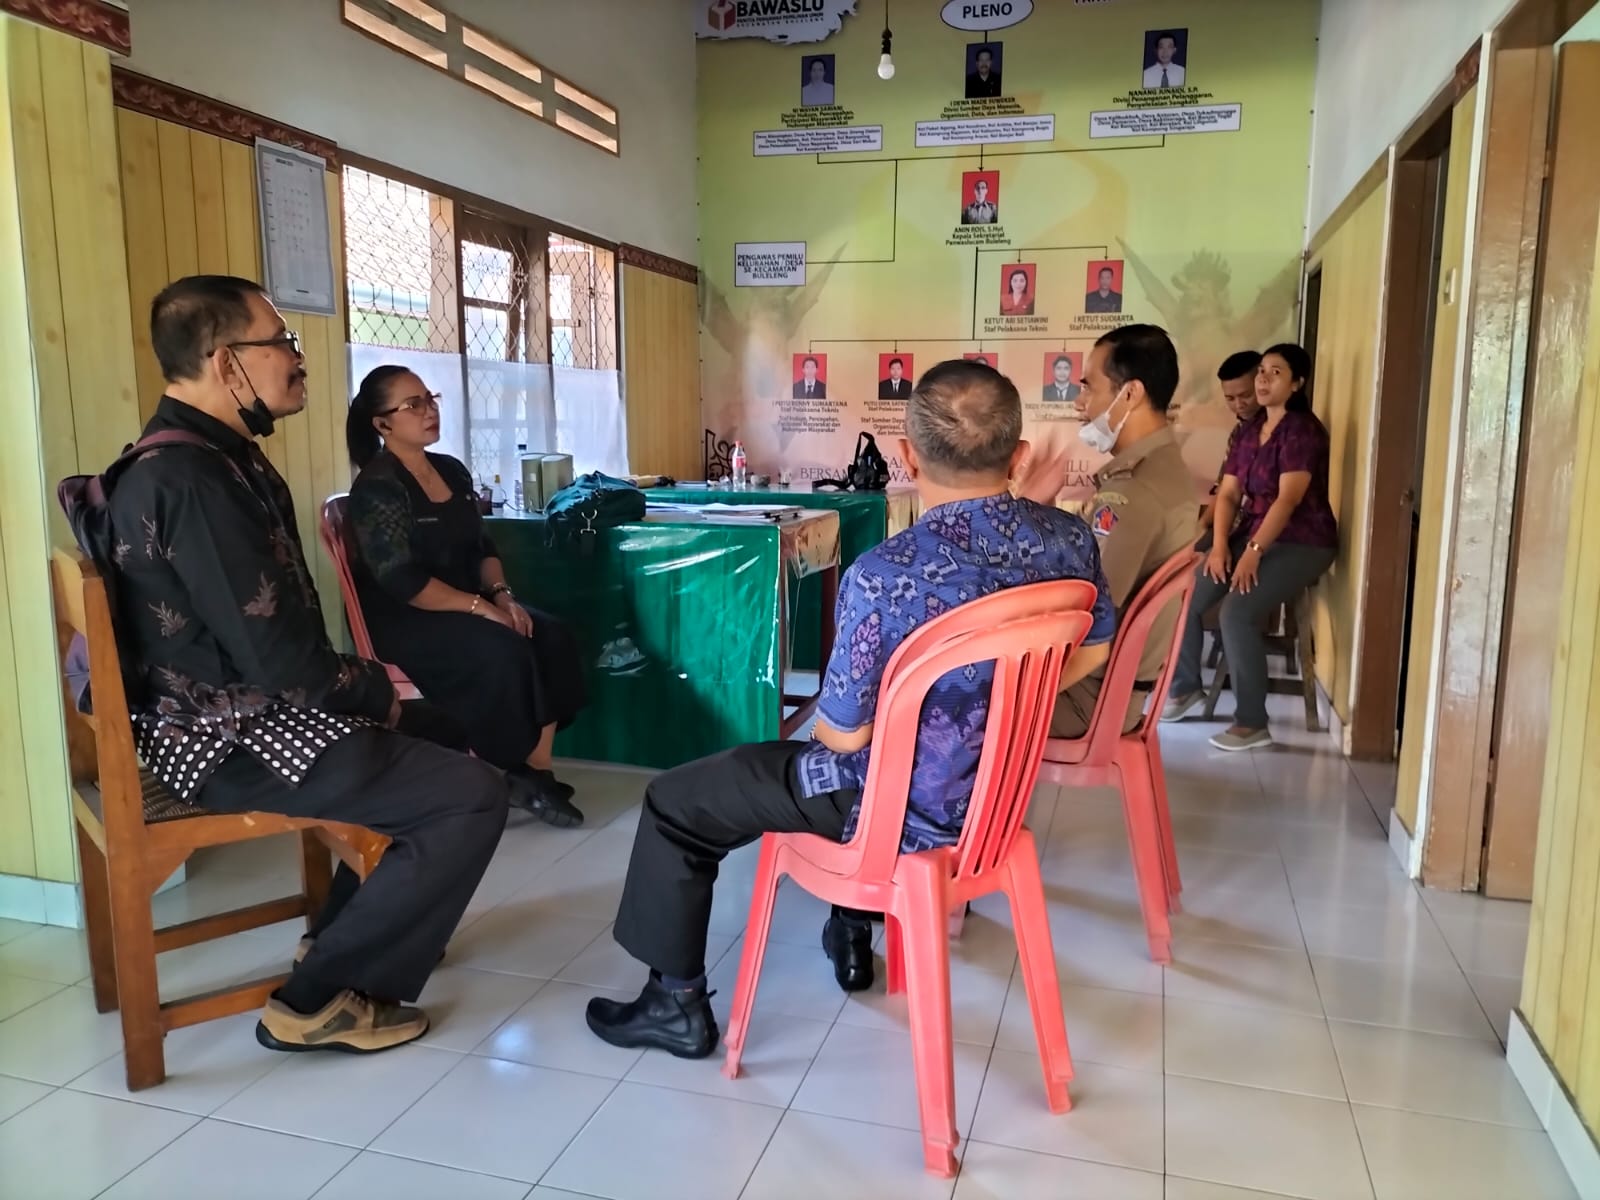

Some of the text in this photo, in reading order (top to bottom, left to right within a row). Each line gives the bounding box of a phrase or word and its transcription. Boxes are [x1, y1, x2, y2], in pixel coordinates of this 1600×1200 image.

[737, 0, 824, 17] BAWASLU
[963, 2, 1012, 19] PLENO
[952, 233, 972, 241] Kepala
[1077, 315, 1099, 323] KETUT
[1100, 314, 1134, 322] SUDIARTA
[984, 325, 996, 333] Staf
[1069, 323, 1082, 331] Staf
